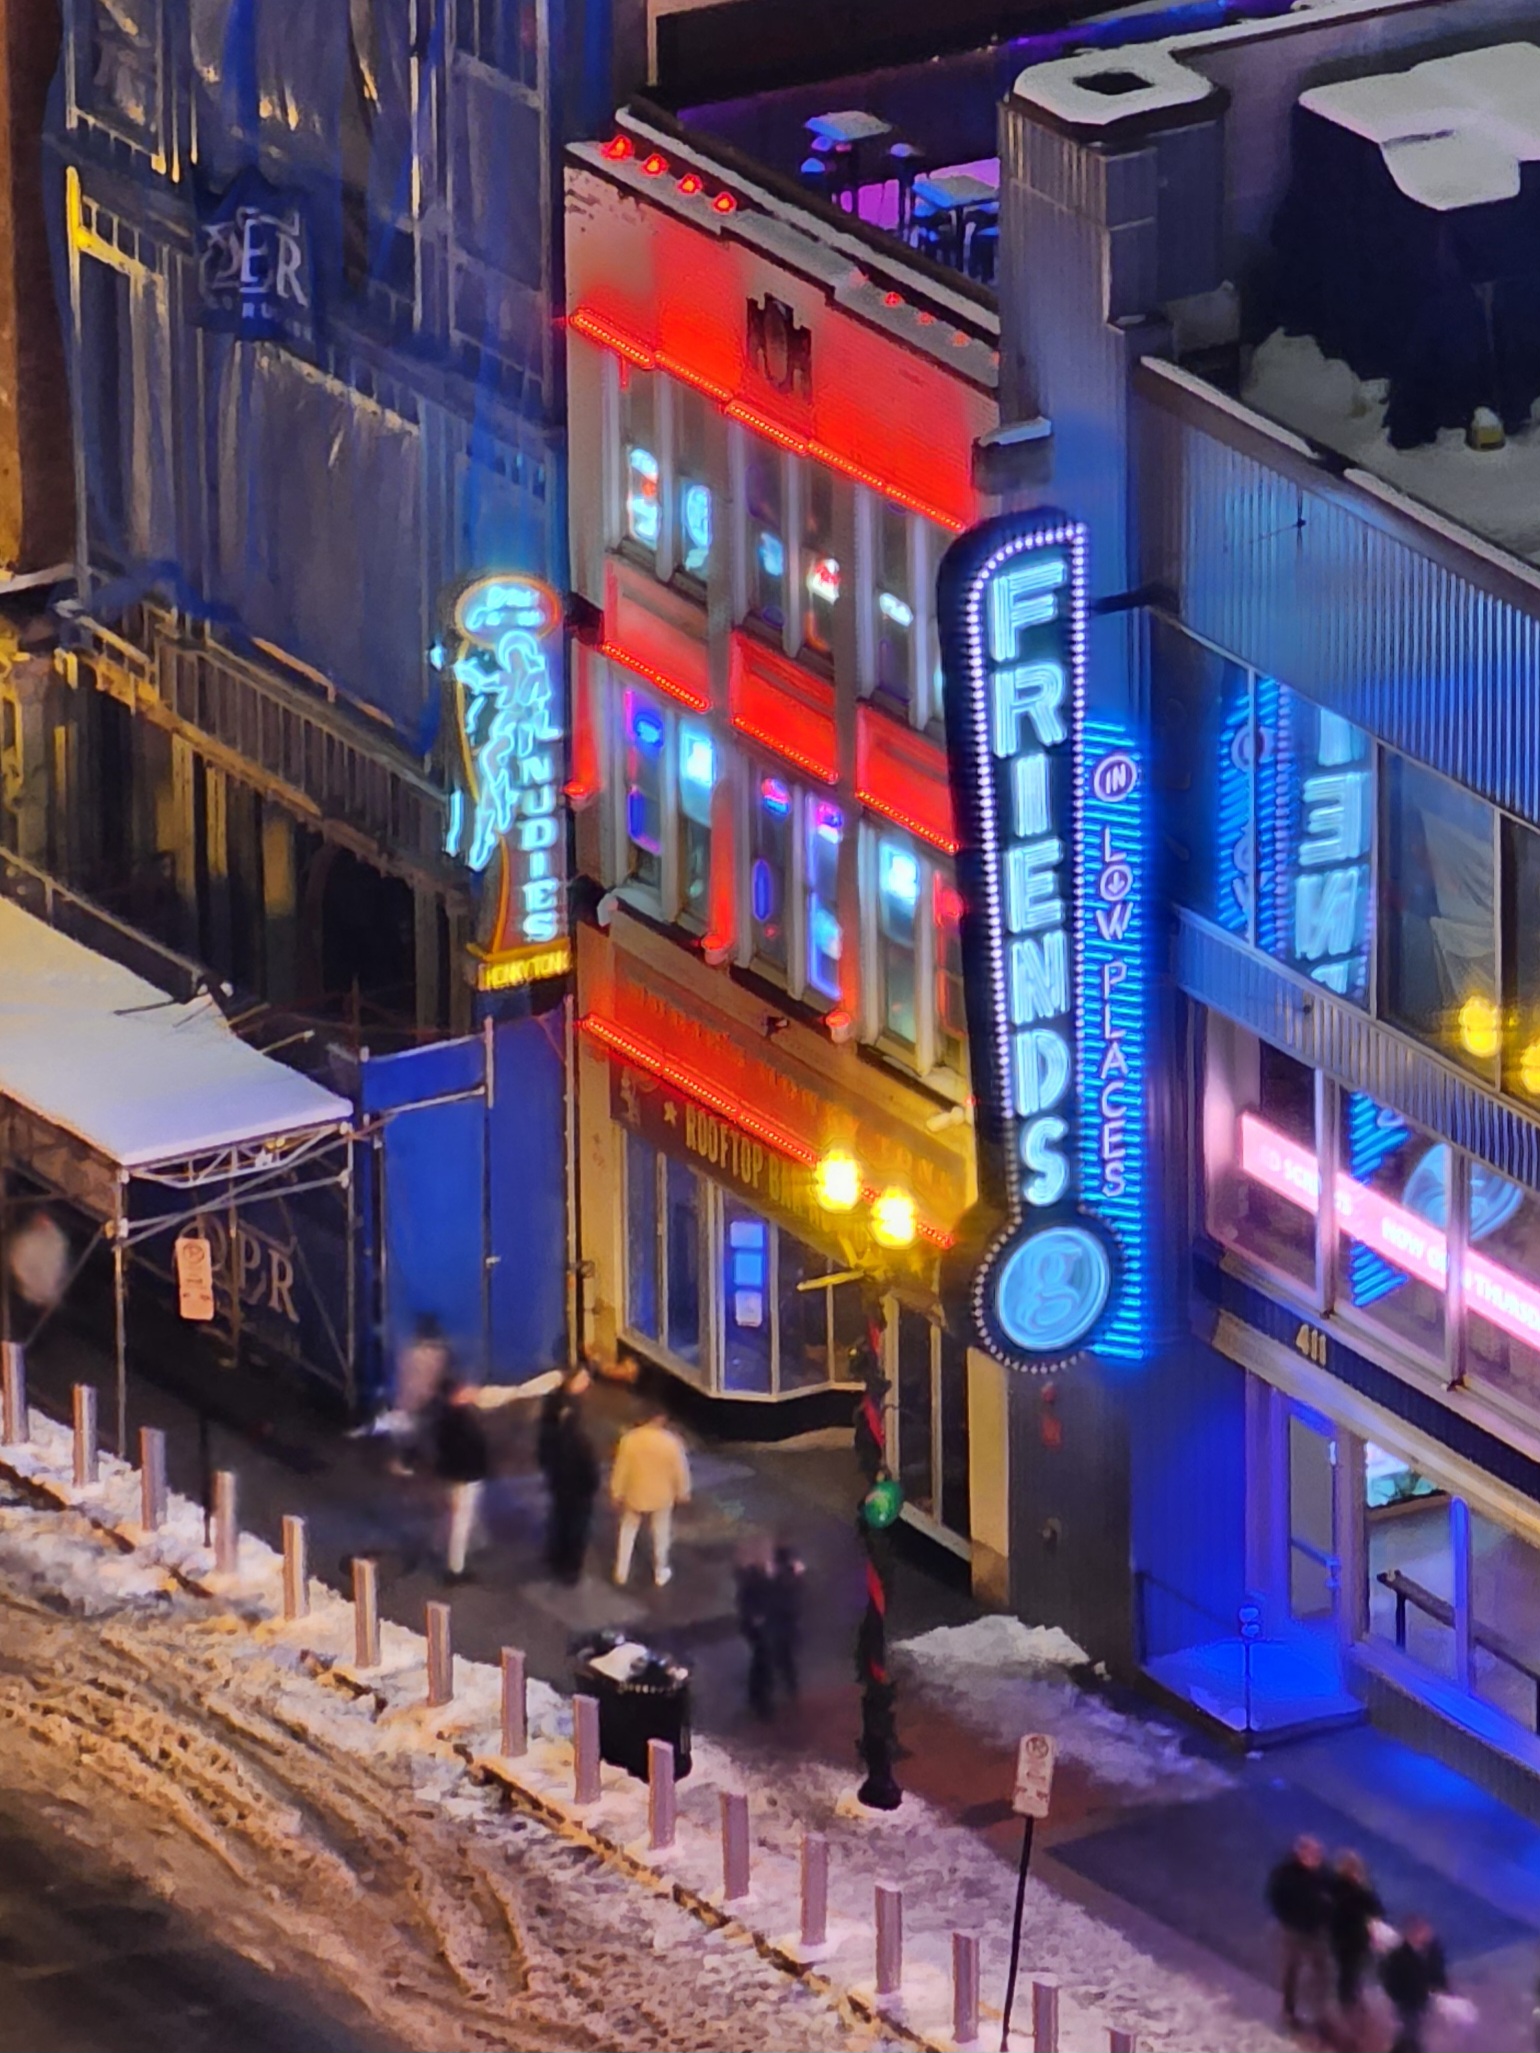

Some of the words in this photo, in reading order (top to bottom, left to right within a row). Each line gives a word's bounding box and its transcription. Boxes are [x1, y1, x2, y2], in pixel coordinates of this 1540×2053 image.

[1104, 762, 1127, 795] IN
[519, 755, 559, 942] NUDIES
[988, 560, 1069, 1208] FRIENDS
[1096, 826, 1134, 941] LOW
[1101, 961, 1128, 1198] PLACES
[686, 1102, 764, 1189] ROOFTOP
[1295, 1323, 1327, 1366] 411
